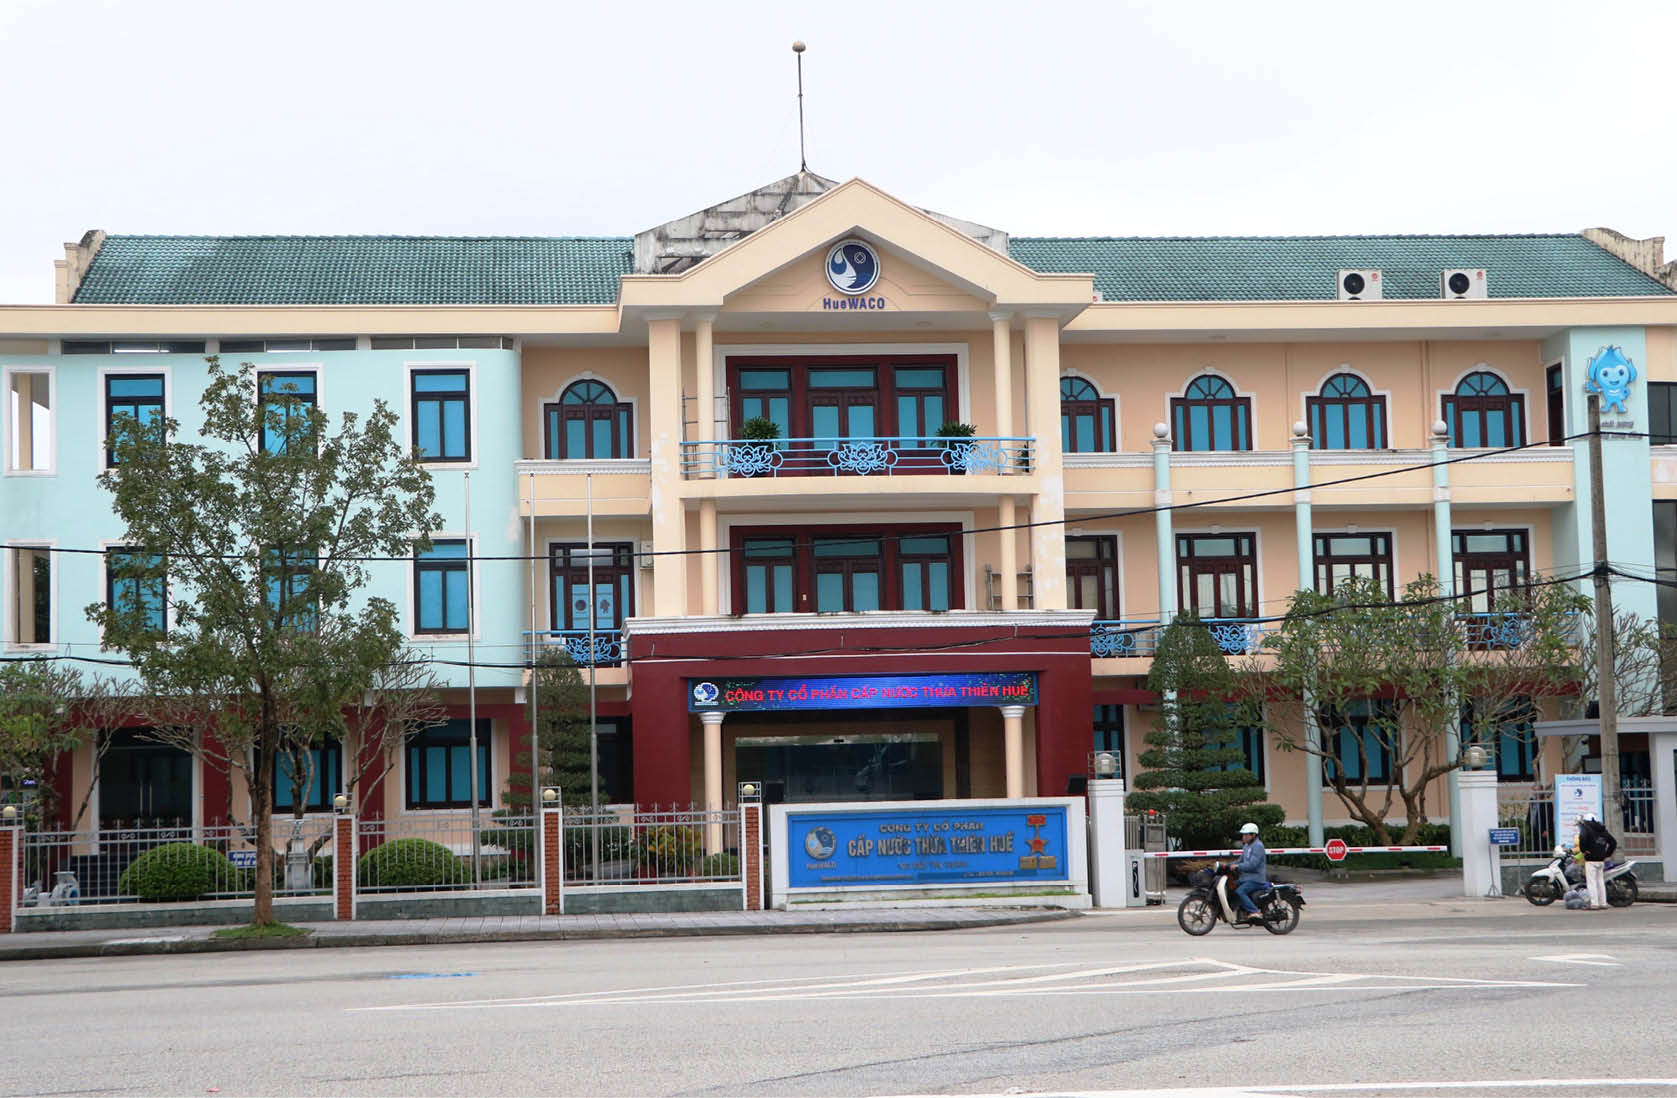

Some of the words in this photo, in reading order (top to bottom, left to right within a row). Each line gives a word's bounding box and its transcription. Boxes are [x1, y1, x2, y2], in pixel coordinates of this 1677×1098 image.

[823, 297, 885, 309] HueWACO
[725, 687, 763, 702] CÔNG
[767, 690, 784, 701] TY
[788, 684, 808, 700] CỔ
[851, 684, 877, 699] CẤP
[960, 682, 998, 696] THIÊN
[1002, 680, 1029, 696] HUẾ
[879, 822, 911, 832] CÔNG
[915, 822, 930, 832] TY
[933, 819, 950, 832] CỔ
[848, 833, 874, 856] CẤP
[877, 834, 912, 855] NƯỚC
[914, 832, 947, 855] THỪA
[951, 833, 985, 854] THIÊN
[989, 830, 1015, 852] HUẾ
[1328, 846, 1344, 855] STOP
